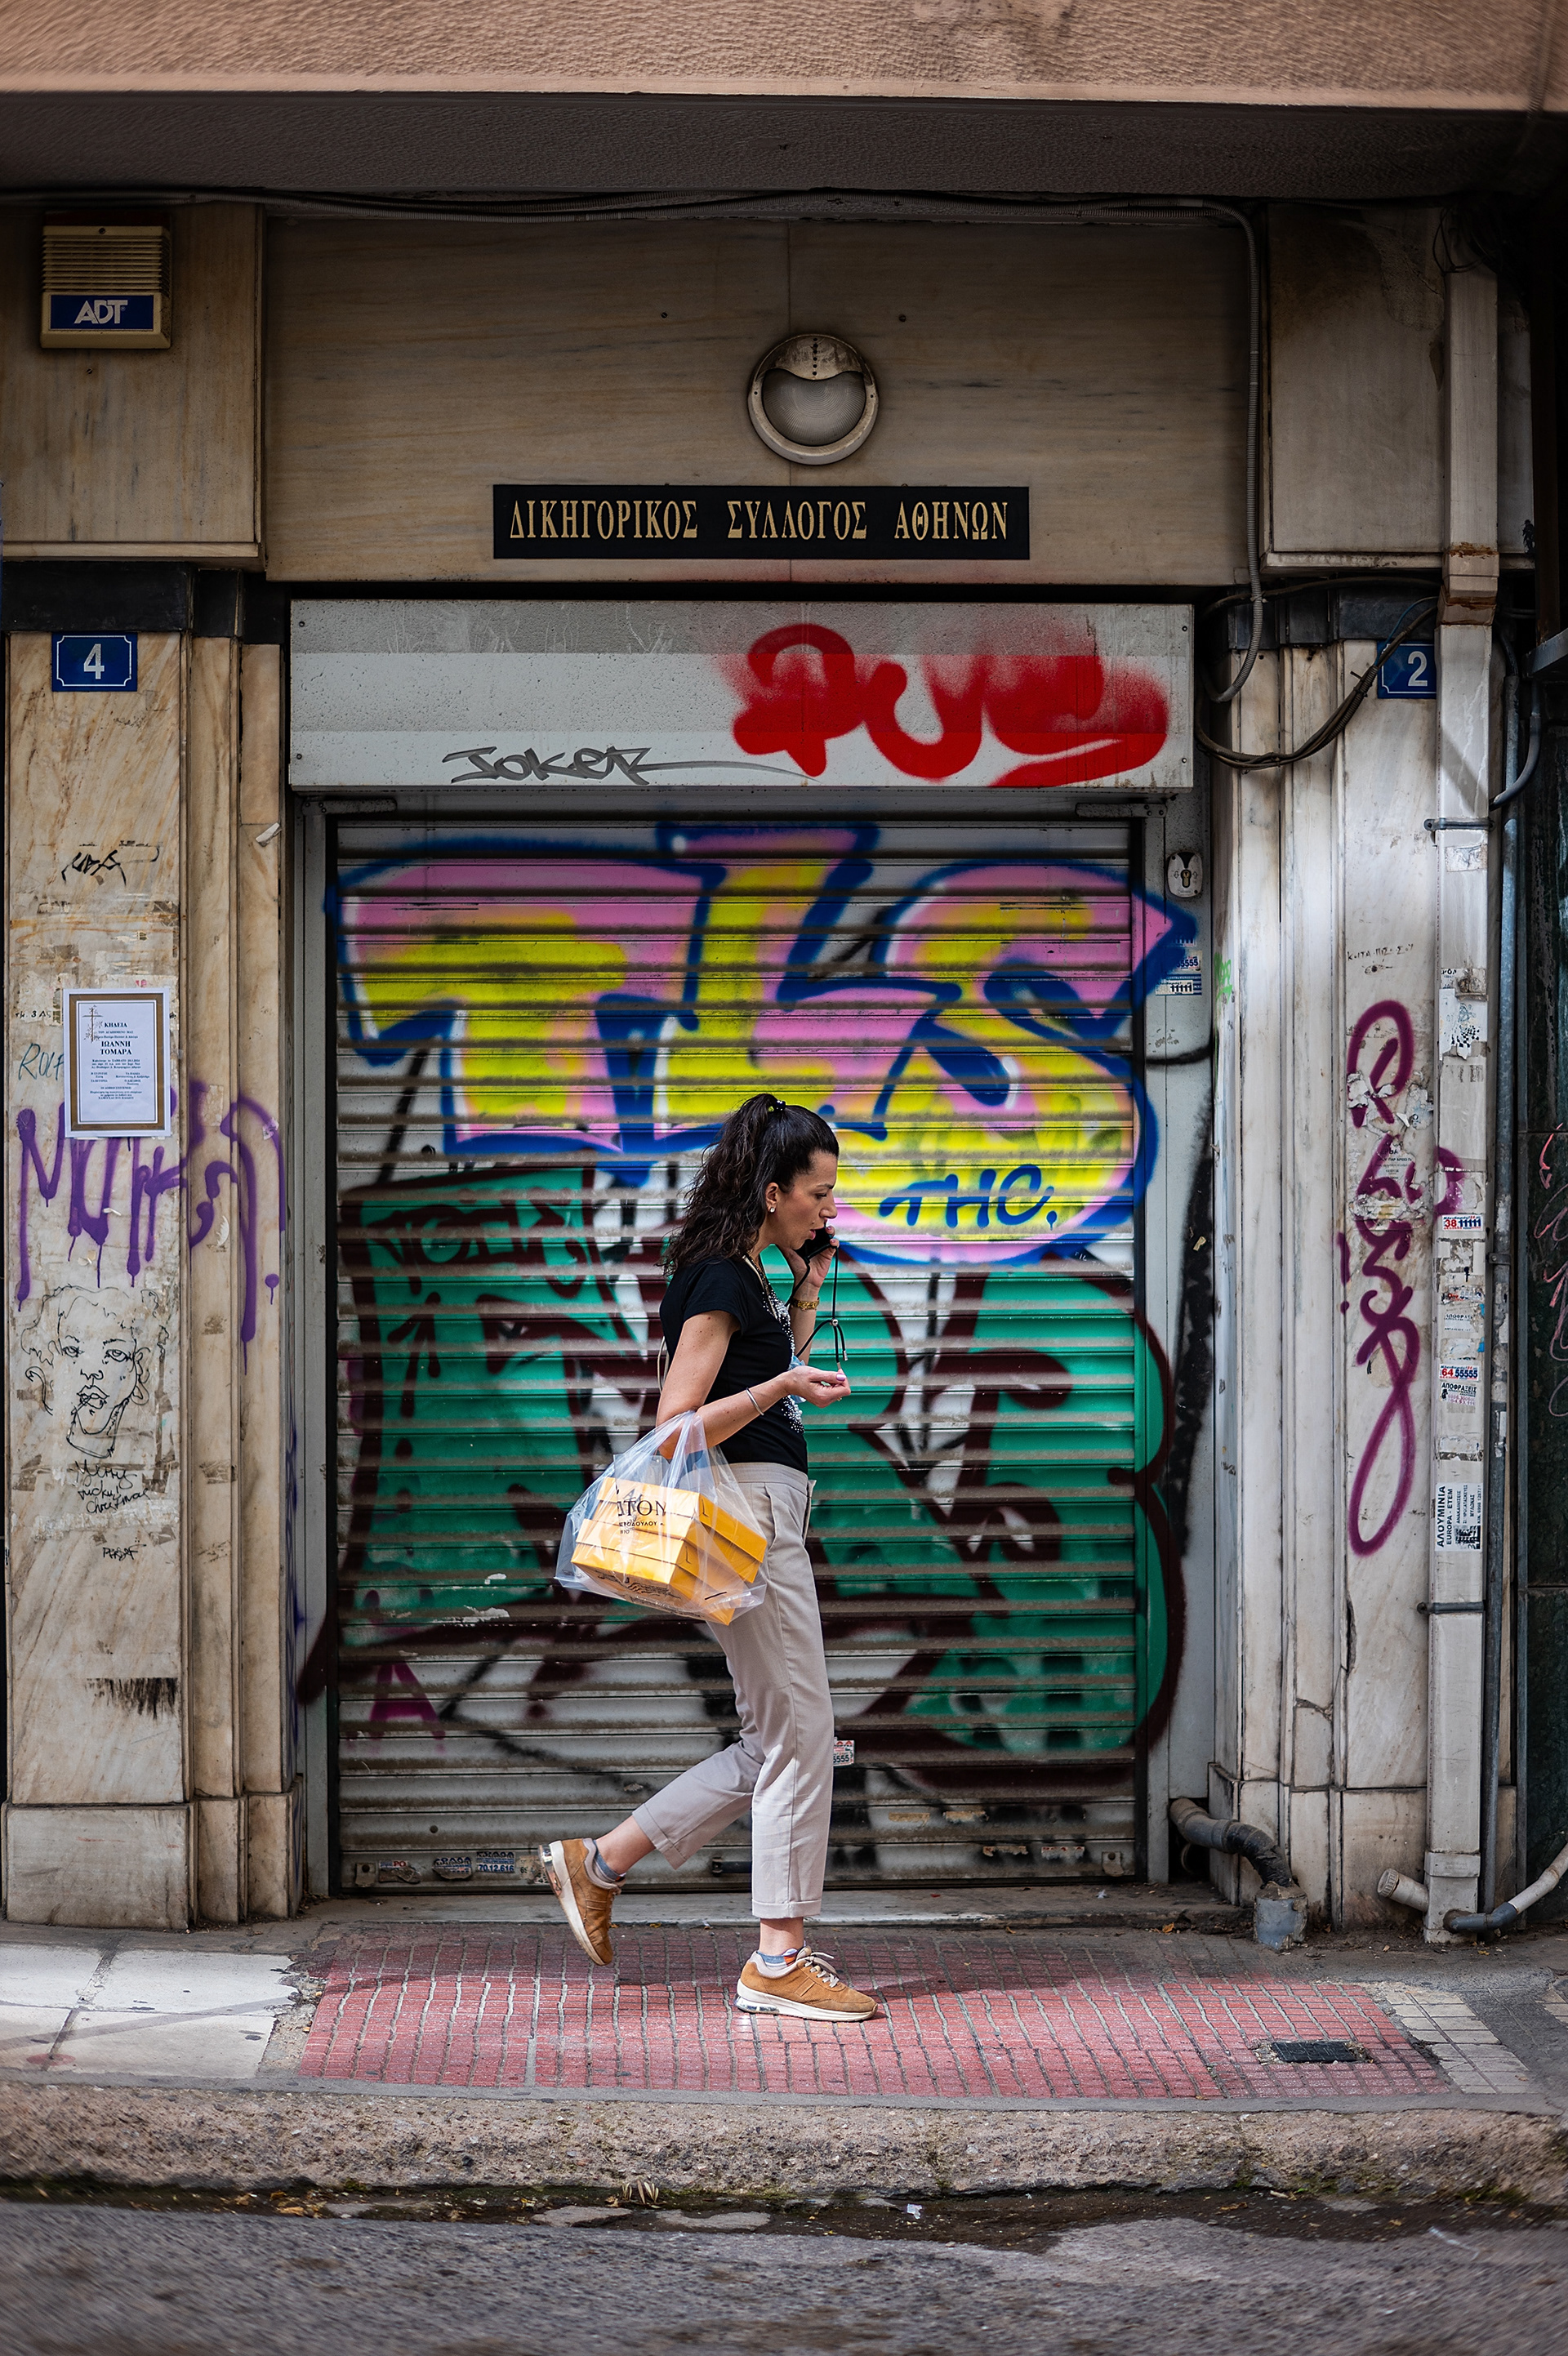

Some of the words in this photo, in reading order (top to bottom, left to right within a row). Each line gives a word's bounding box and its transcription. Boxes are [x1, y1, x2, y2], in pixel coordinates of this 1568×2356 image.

[74, 299, 128, 324] ADT
[510, 500, 698, 540] ΔΙΚΗΓΟΡΙΚΟΣ
[728, 501, 867, 540] ΣΥΛΛΟΓΟΣ
[894, 501, 1009, 541] ΑΘΗΝΩΝ
[83, 644, 105, 679] 4
[1407, 651, 1428, 687] 2
[1437, 1485, 1446, 1548] ΑΛΟΥΜΙΝΙΑ
